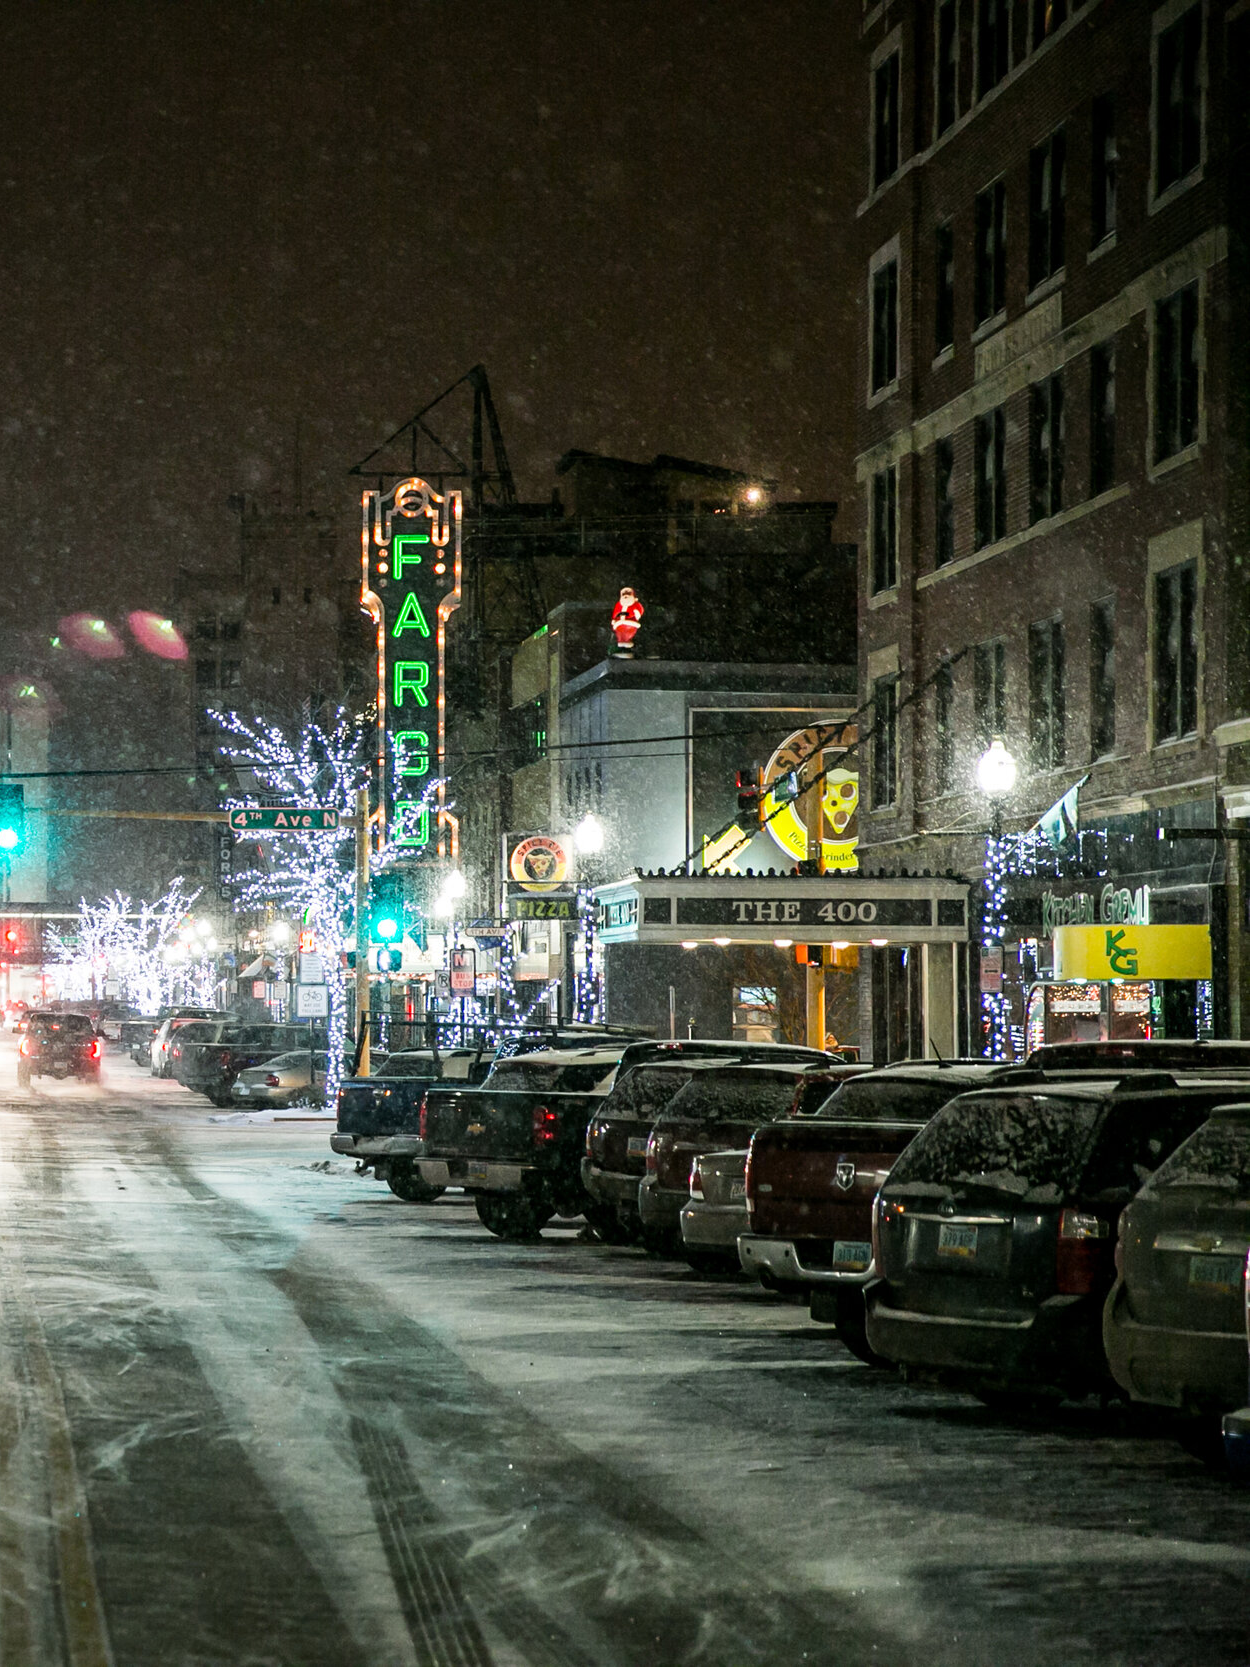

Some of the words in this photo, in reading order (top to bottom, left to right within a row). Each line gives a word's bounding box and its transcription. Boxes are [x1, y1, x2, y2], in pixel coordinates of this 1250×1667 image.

[392, 534, 430, 846] FARGO
[274, 812, 311, 827] Ave
[323, 812, 336, 826] N
[516, 901, 570, 917] PIZZA
[732, 901, 801, 922] THE
[818, 901, 878, 922] 400
